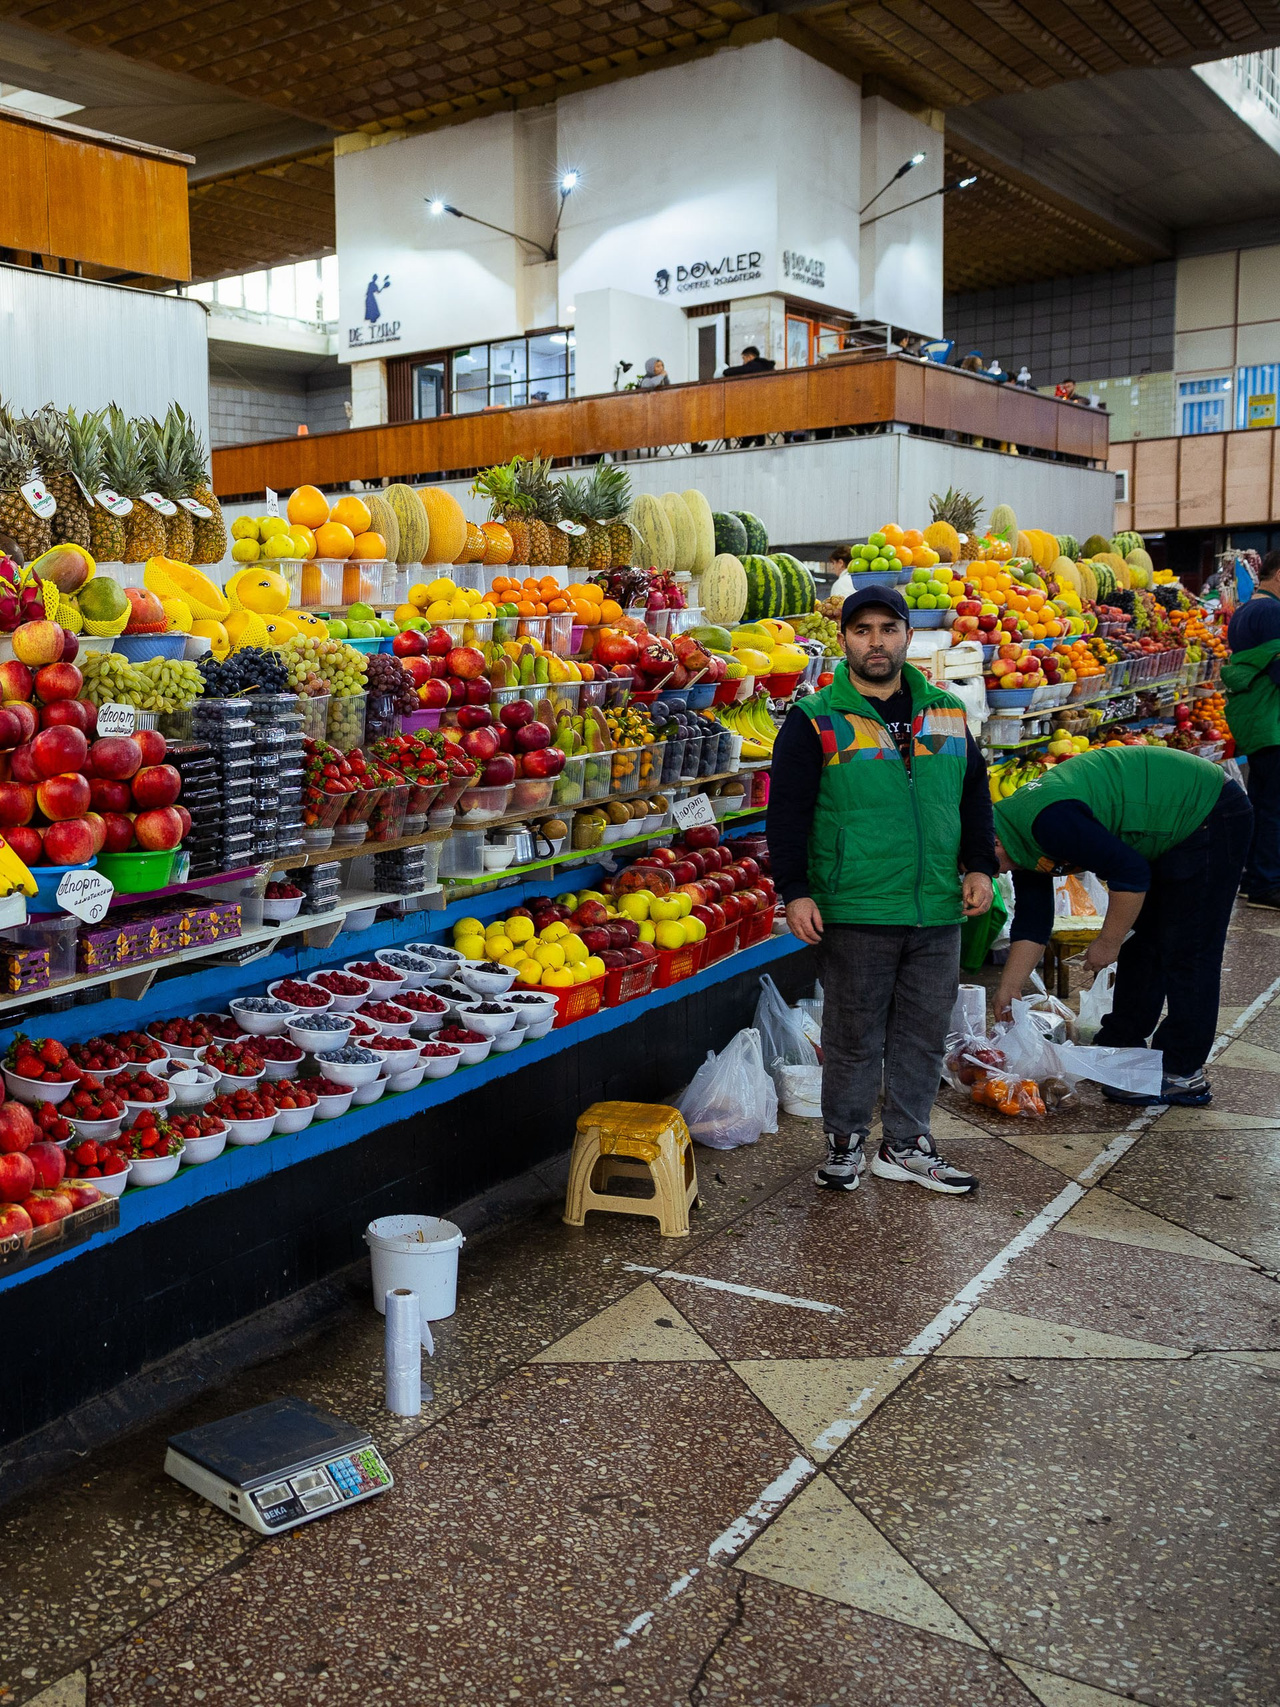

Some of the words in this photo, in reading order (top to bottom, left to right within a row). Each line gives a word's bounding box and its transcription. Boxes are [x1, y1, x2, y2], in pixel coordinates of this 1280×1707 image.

[677, 252, 762, 282] BOWLER
[677, 279, 711, 292] COFFEE
[349, 328, 364, 343] DE
[58, 874, 101, 897] Апорт
